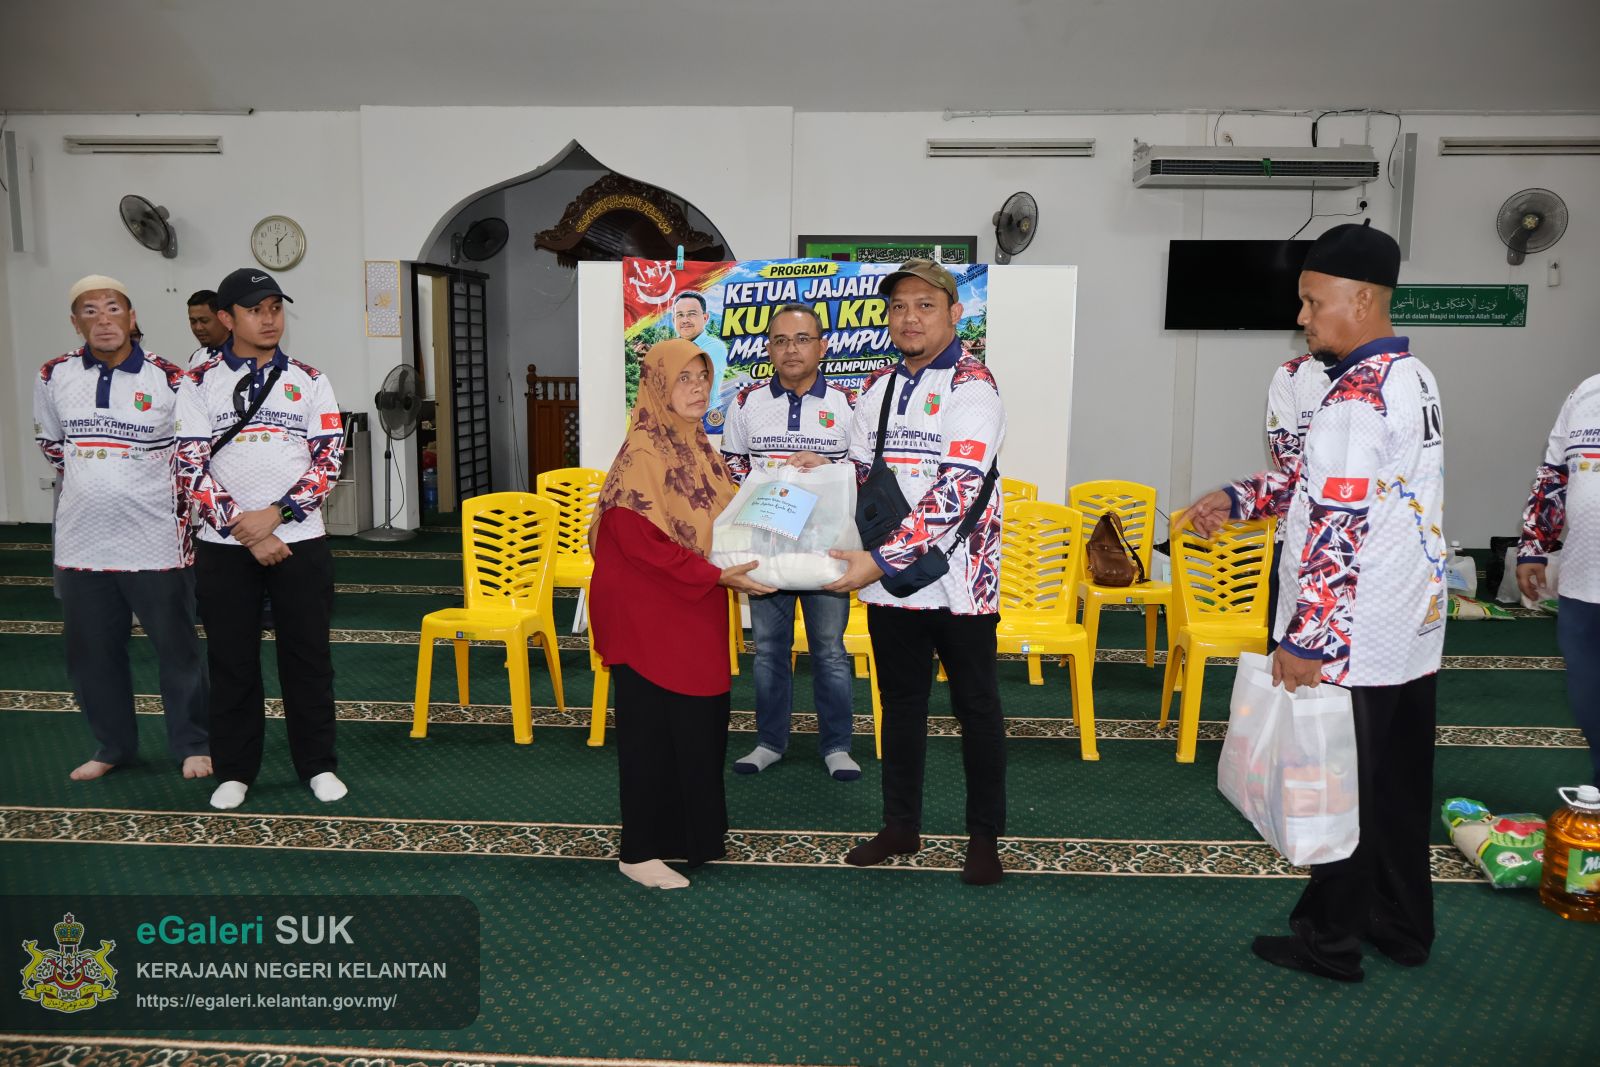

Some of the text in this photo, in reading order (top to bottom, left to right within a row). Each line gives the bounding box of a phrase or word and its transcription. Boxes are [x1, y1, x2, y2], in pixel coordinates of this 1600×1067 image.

[770, 264, 828, 276] PROGRAM
[725, 275, 887, 305] KETUA JAJAH
[722, 302, 830, 337] KUA
[1430, 313, 1448, 321] Masjid
[822, 327, 897, 354] AMPU
[825, 358, 890, 372] KAMPUNG)
[69, 419, 102, 427] MASUK
[104, 420, 155, 434] KAMPUNG
[763, 436, 793, 444] MASUK
[794, 437, 838, 446] KAMPUNG
[901, 429, 942, 443] AMPUNG
